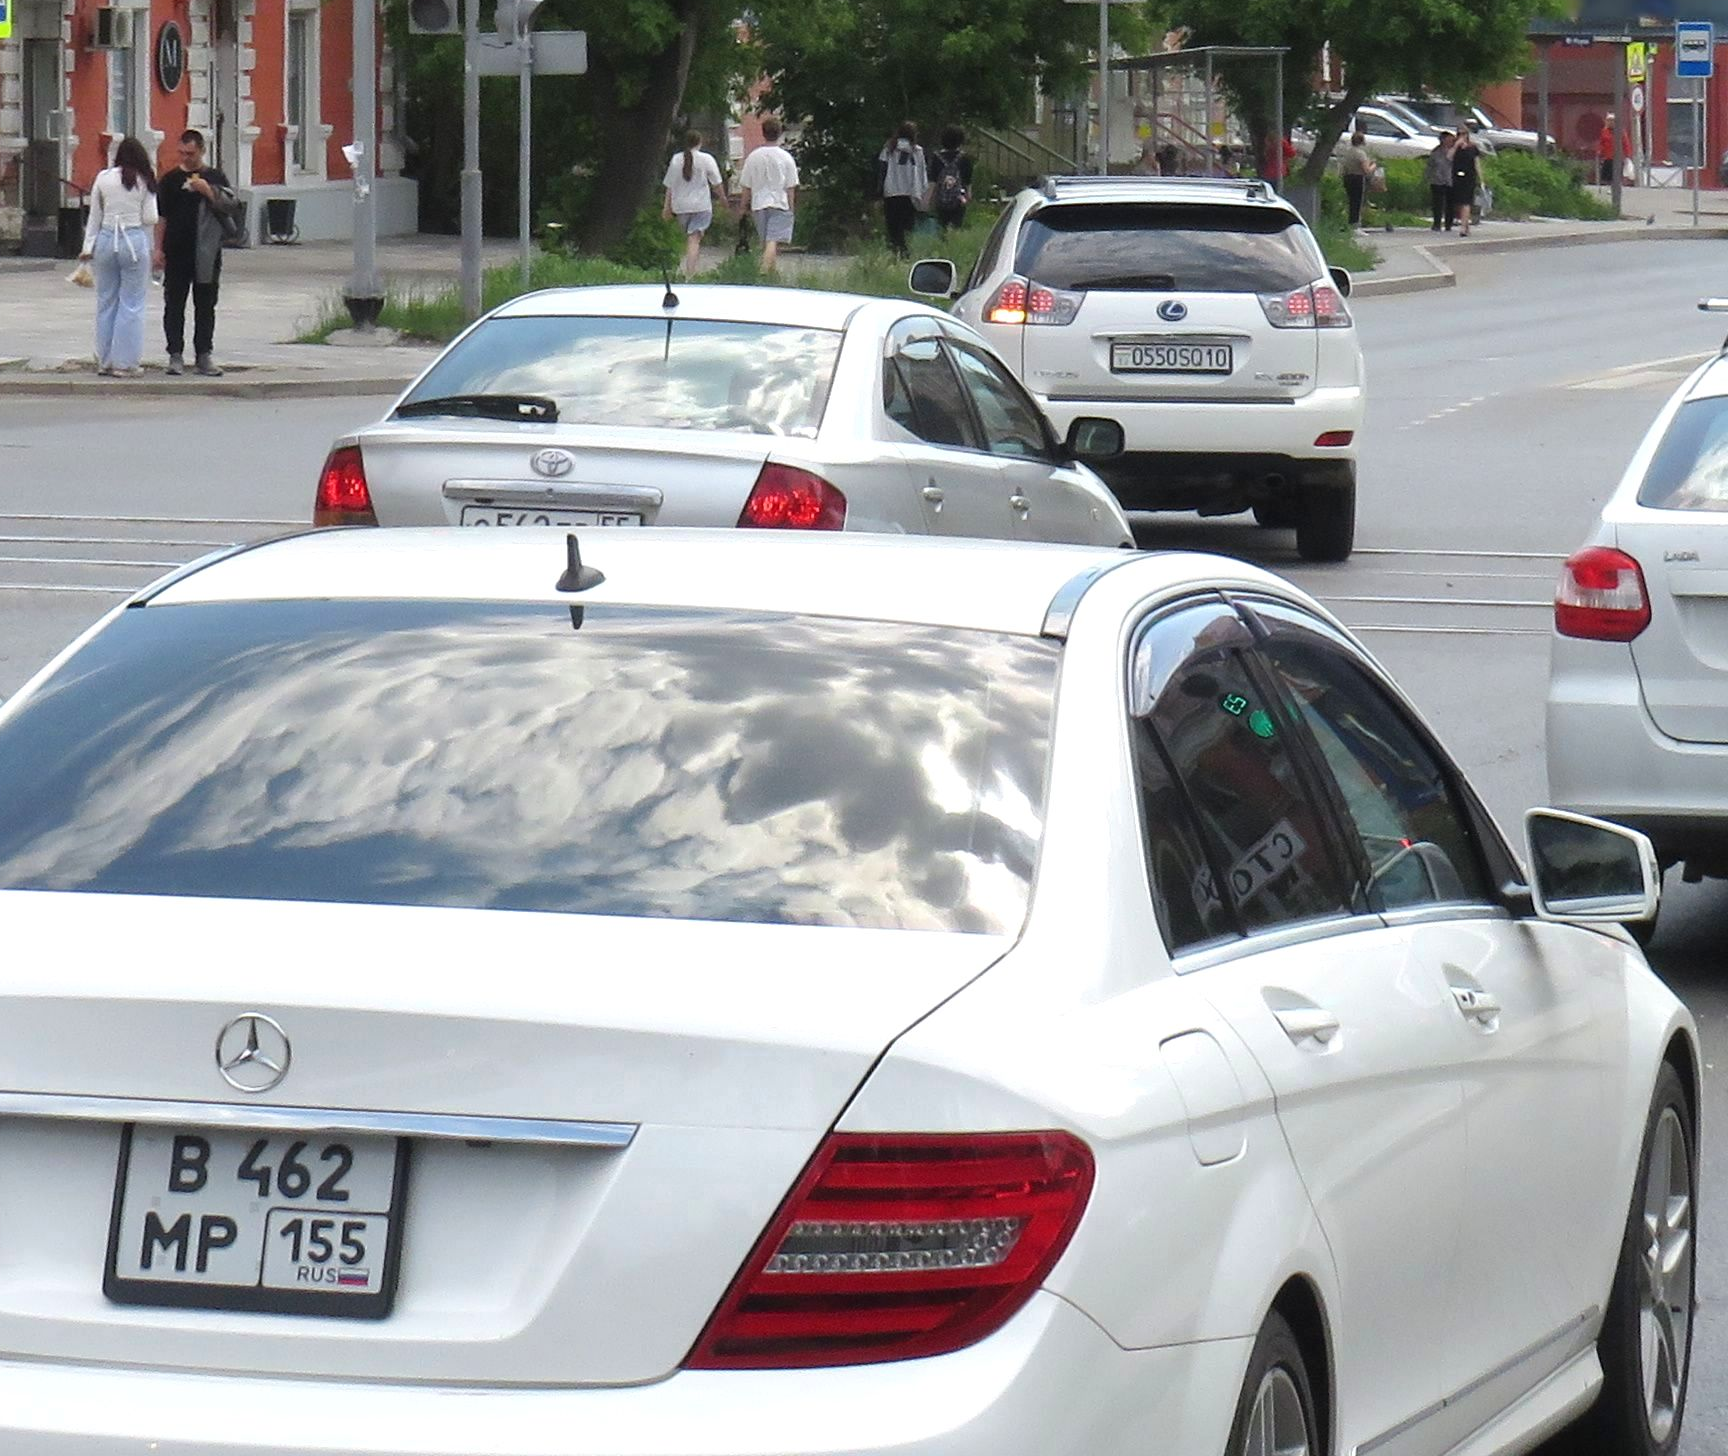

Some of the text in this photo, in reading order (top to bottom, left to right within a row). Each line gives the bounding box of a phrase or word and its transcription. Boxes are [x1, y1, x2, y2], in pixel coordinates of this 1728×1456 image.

[237, 1139, 354, 1202] 462
[280, 1218, 367, 1265] 155
[297, 1265, 337, 1283] RUS
